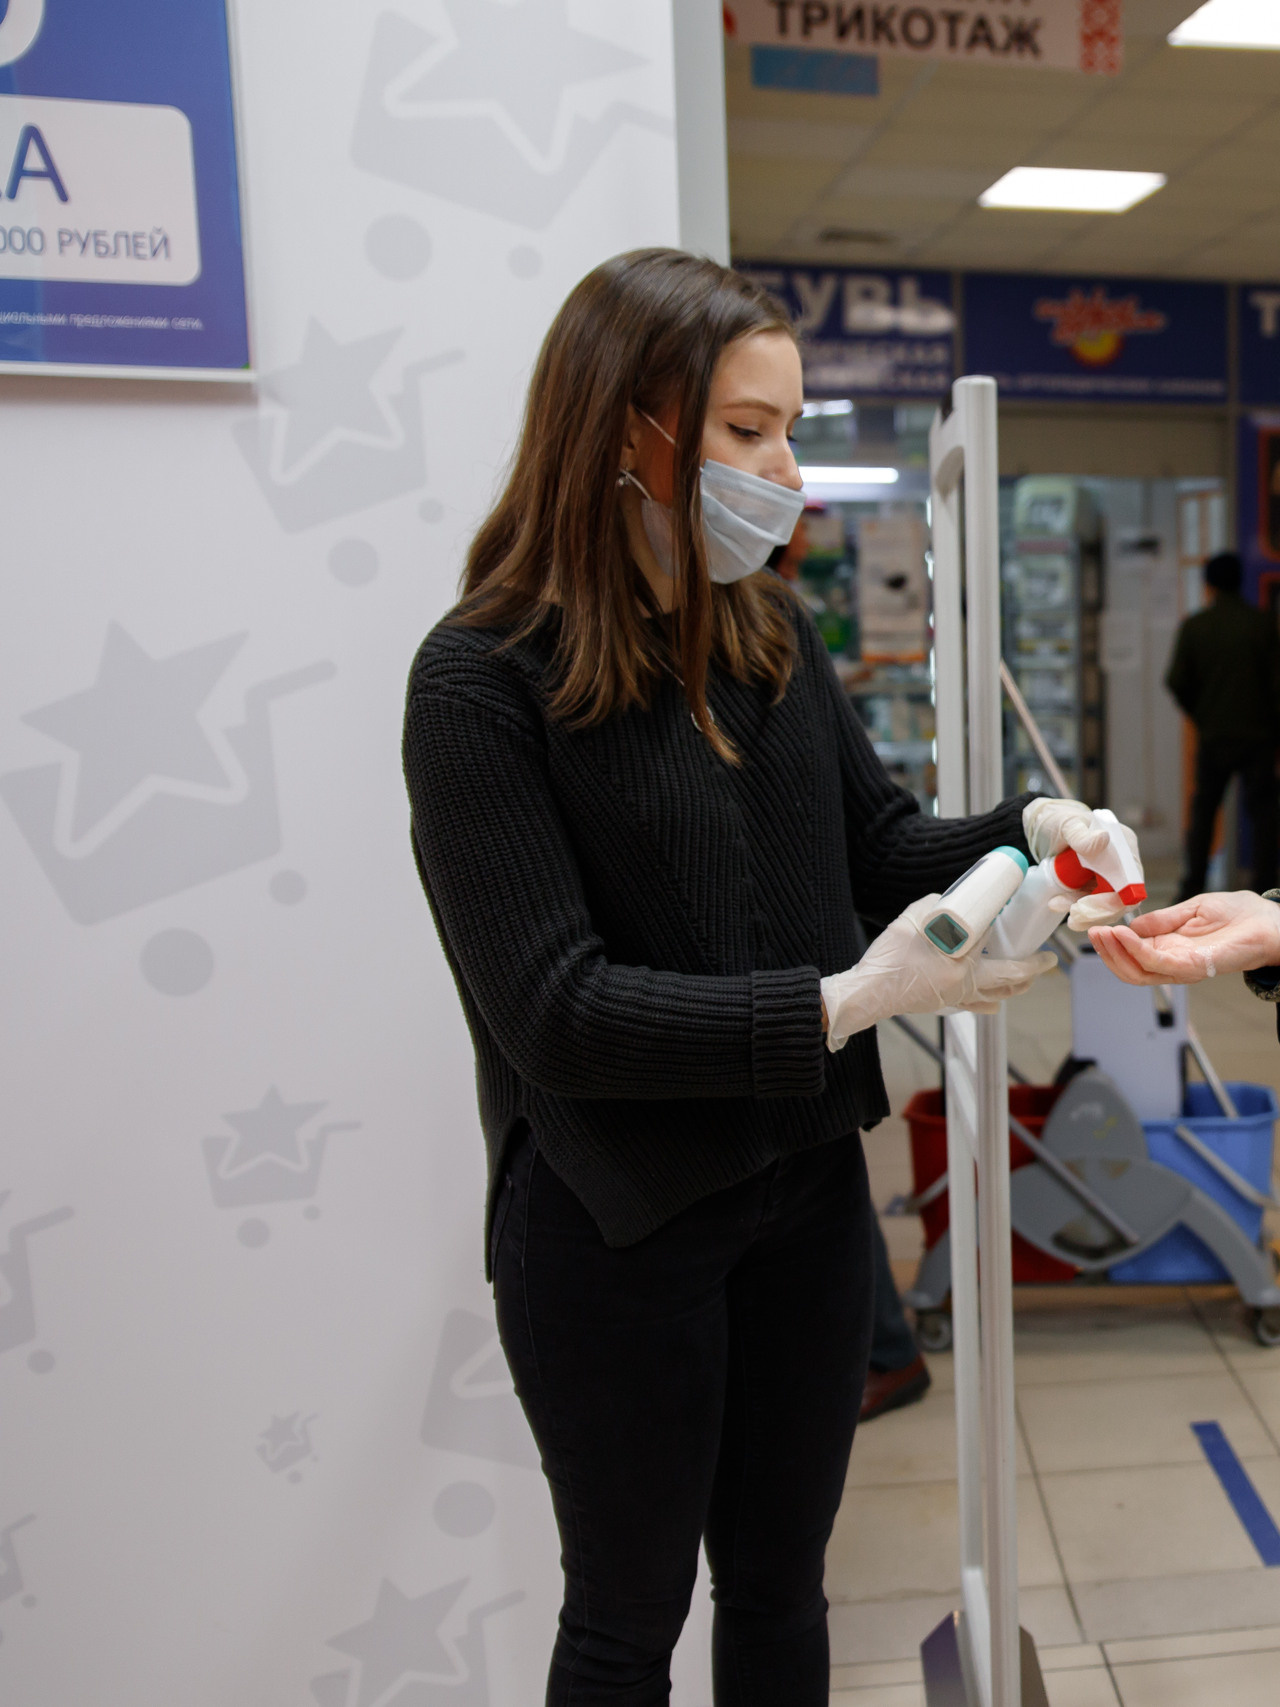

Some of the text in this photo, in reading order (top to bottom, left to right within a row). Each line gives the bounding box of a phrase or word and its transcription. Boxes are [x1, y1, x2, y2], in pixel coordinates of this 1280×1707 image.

[773, 0, 1042, 57] ТРИКОТАЖ
[0, 122, 69, 202] А
[57, 226, 171, 261] РУБЛЕЙ
